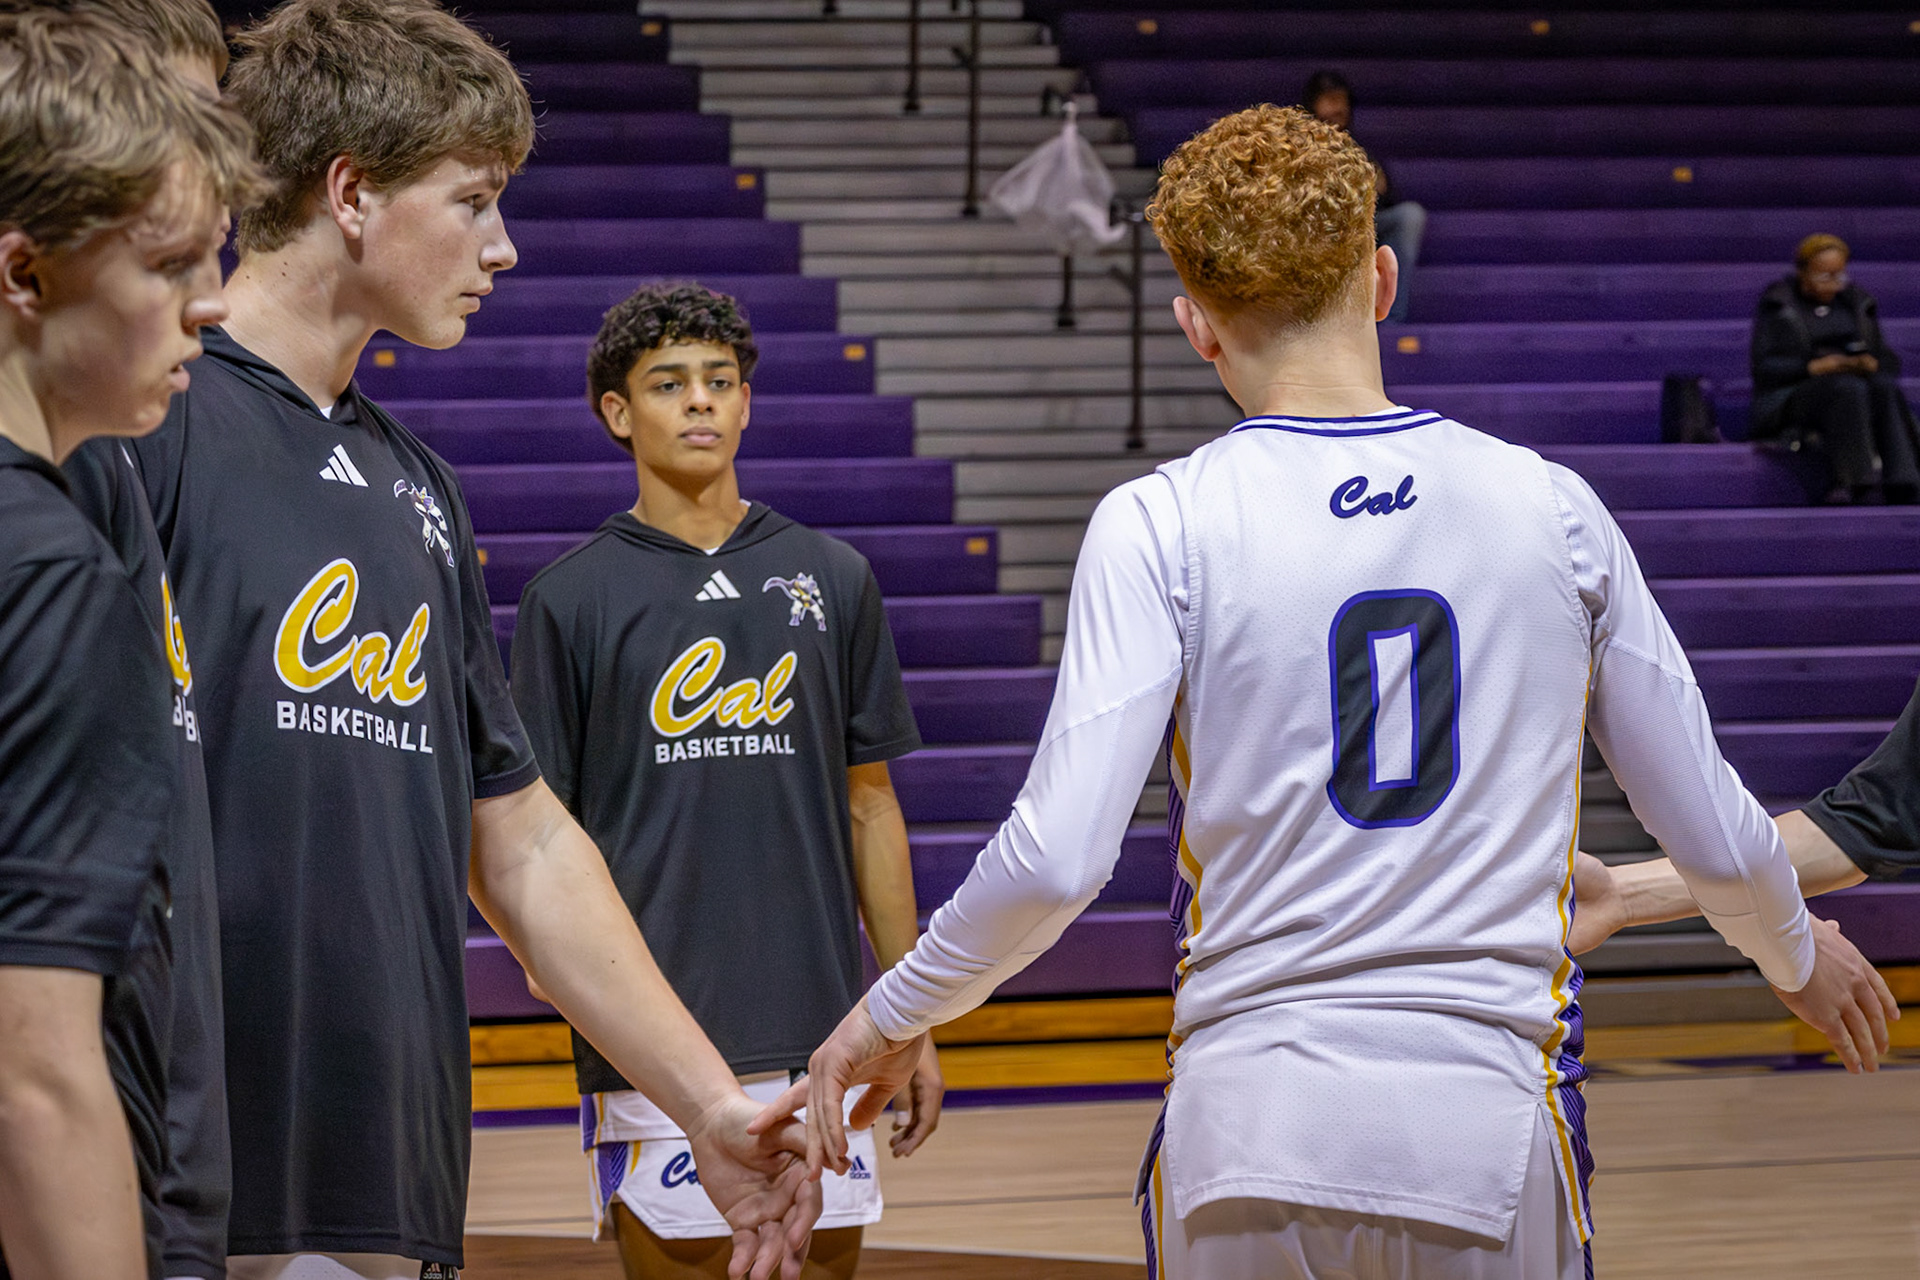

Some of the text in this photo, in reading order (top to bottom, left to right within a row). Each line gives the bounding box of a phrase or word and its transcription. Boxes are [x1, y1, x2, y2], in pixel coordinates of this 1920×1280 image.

[1329, 474, 1418, 519] Cal
[273, 558, 430, 706] Cal
[649, 636, 798, 738] Cal
[1326, 588, 1462, 830] 0
[276, 700, 433, 755] BASKETBALL
[655, 733, 796, 764] BASKETBALL
